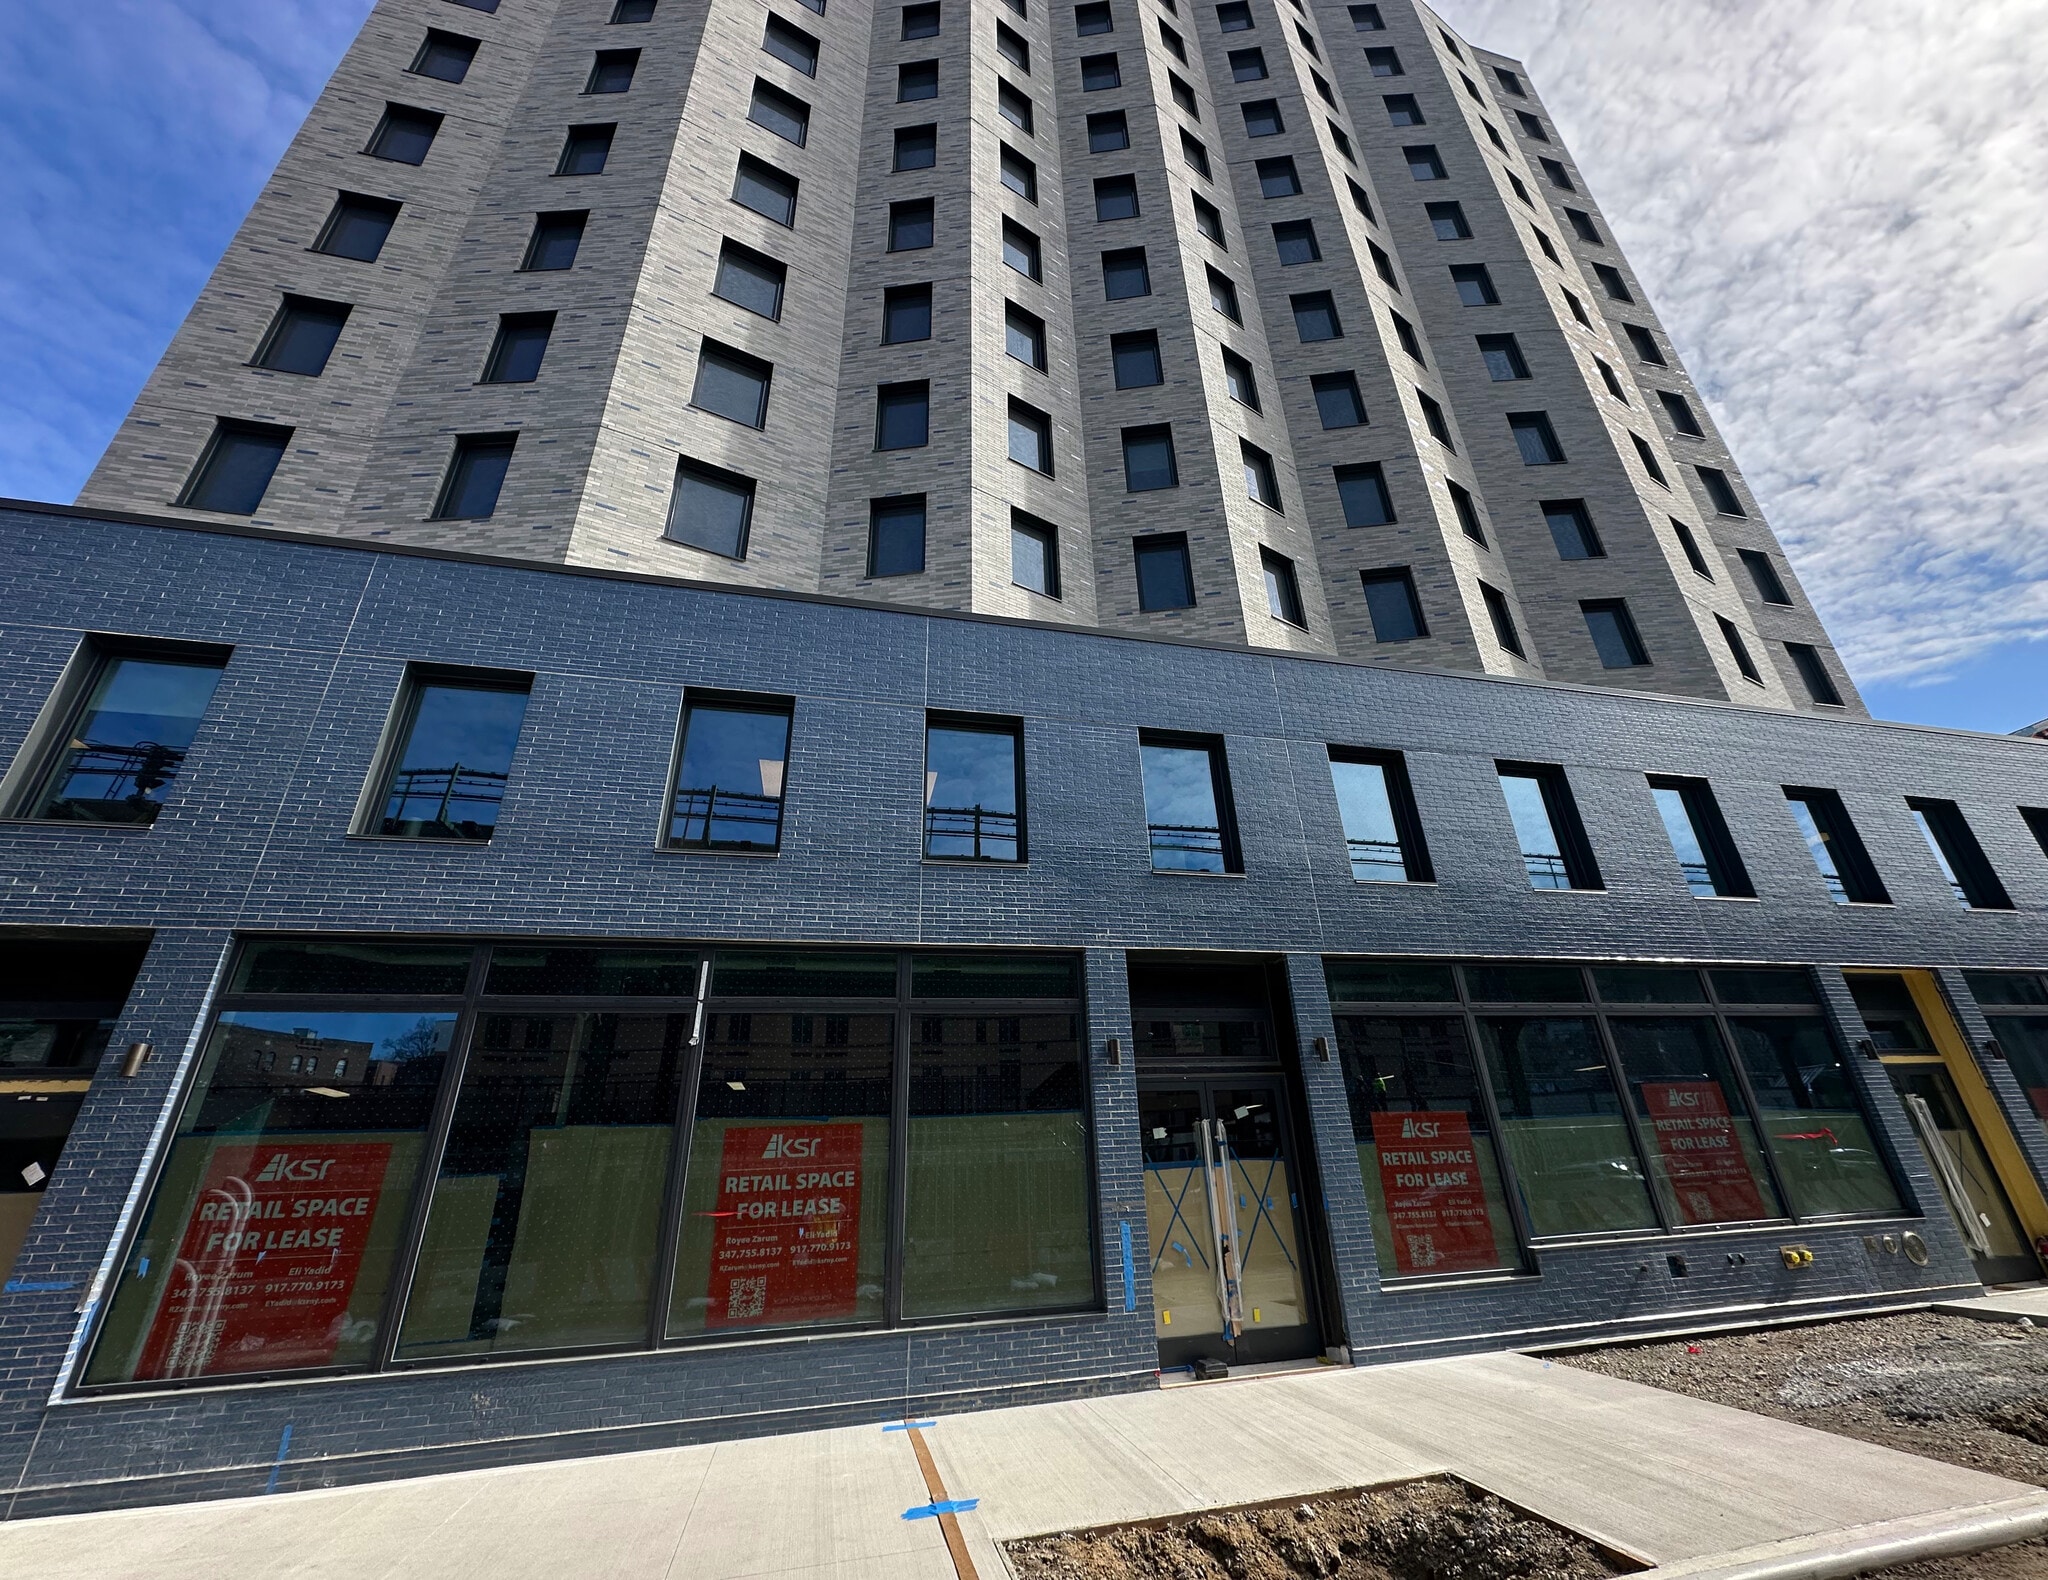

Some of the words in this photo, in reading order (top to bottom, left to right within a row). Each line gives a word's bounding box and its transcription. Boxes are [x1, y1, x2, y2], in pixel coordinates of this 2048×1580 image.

[1656, 1118, 1695, 1131] RETAIL
[1697, 1116, 1732, 1130] SPACE
[1671, 1137, 1696, 1151] FOR
[1695, 1135, 1731, 1149] LEASE
[1381, 1151, 1429, 1166] RETAIL
[1430, 1150, 1473, 1165] SPACE
[725, 1174, 792, 1194] RETAIL
[795, 1170, 855, 1190] SPACE
[1395, 1173, 1426, 1188] FOR
[1426, 1171, 1469, 1187] LEASE
[198, 1200, 285, 1222] RETAIL
[292, 1197, 370, 1218] SPACE
[736, 1201, 777, 1220] FOR
[781, 1197, 841, 1217] LEASE
[205, 1230, 260, 1252] FOR
[263, 1227, 344, 1250] LEASE
[752, 1234, 778, 1243] Zarum
[718, 1246, 783, 1260] 347.755.8137
[790, 1241, 851, 1255] 917.770.9173
[288, 1267, 302, 1277] Eli
[303, 1265, 332, 1275] Yadid
[264, 1279, 345, 1294] 917.770.9173
